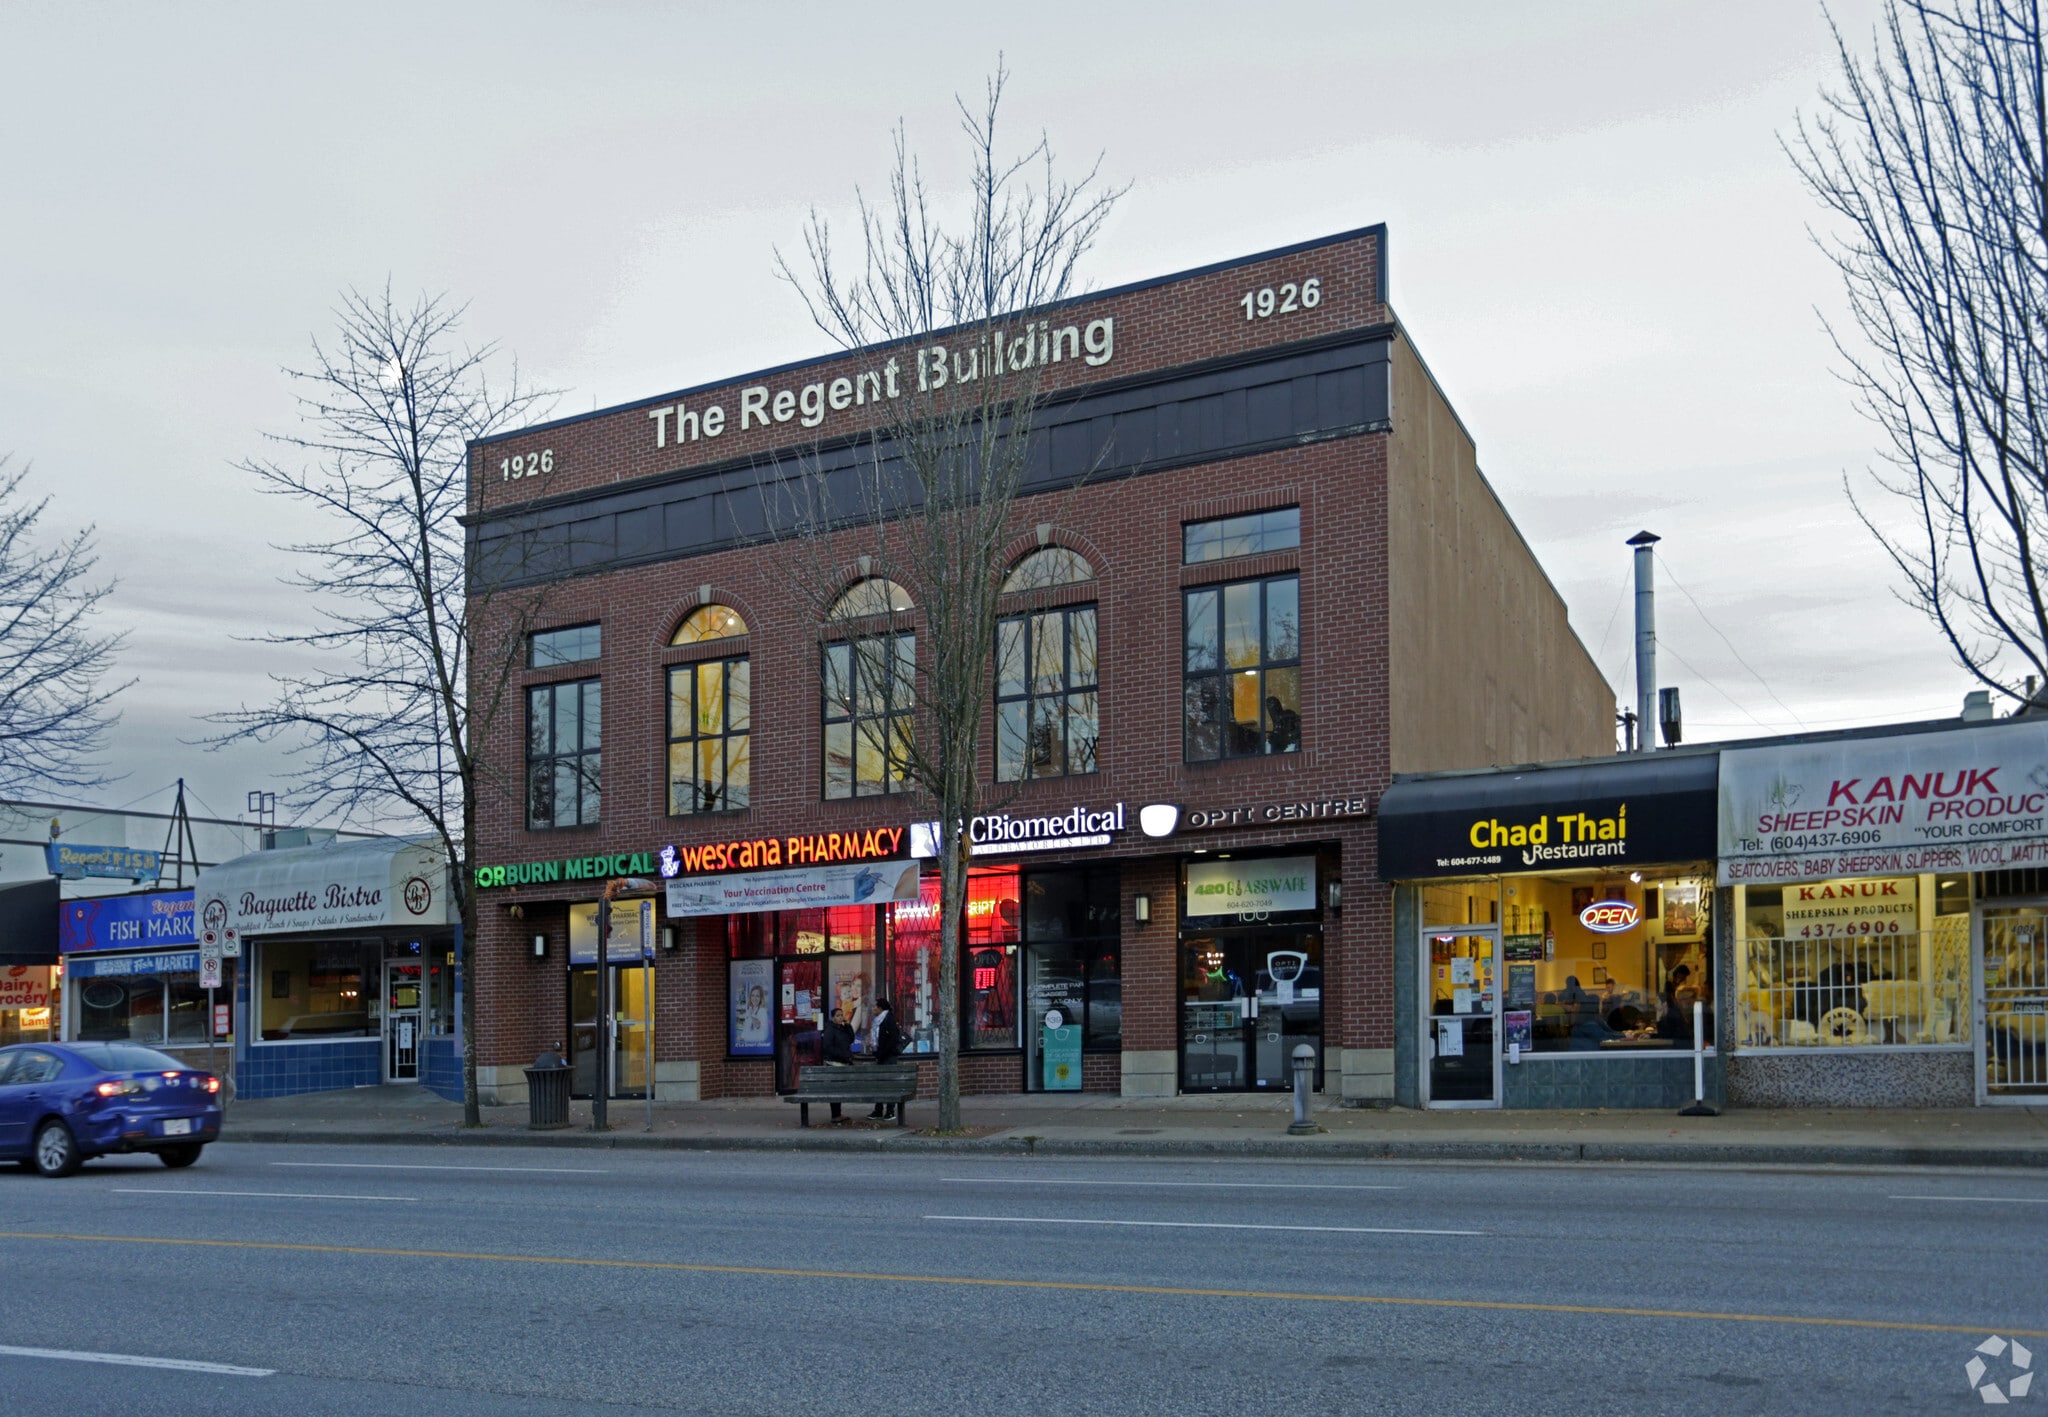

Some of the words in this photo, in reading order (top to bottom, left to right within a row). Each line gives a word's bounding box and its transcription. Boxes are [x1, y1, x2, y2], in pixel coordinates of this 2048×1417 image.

[1240, 279, 1321, 321] 1926
[649, 403, 725, 449] The
[740, 357, 900, 428] Regent
[917, 316, 1114, 393] Building
[500, 449, 554, 481] 1926
[1827, 766, 2001, 807] KANUK
[957, 803, 1125, 843] CBiomedical
[1187, 808, 1255, 828] OPTI
[1263, 799, 1367, 821] CENTRE
[1757, 804, 1904, 834] SHEEPSKIN
[1926, 794, 2048, 822] PRODUC
[1469, 815, 1548, 849] Chad
[1556, 803, 1627, 842] Thai
[1739, 838, 1764, 852] Tel:
[1769, 829, 1882, 853] (604)437-6906
[1914, 823, 1963, 840] "YOUR
[1968, 817, 2044, 836] COMFORT
[788, 828, 904, 864] PHARMACY
[972, 838, 1073, 854] ABORATORIES
[1524, 840, 1626, 864] Restaurant
[112, 852, 155, 870] FISH
[566, 852, 655, 880] MEDICAL
[1436, 858, 1450, 867] Tel:
[1450, 855, 1501, 866] 604-677-1489
[1728, 860, 1801, 880] SEATCOVERS,
[1804, 858, 1835, 876] BABY
[1838, 853, 1904, 875] SHEEPSKIN,
[1904, 848, 1965, 870] SLIPPERS,
[1968, 847, 2006, 865] WOOL
[723, 888, 743, 899] Your
[744, 885, 794, 898] Vaccination
[796, 883, 826, 893] Centre
[1194, 883, 1225, 895] 420
[1799, 881, 1898, 901] KANUK
[238, 891, 317, 922] Baguette
[323, 883, 383, 911] Bistro
[1226, 899, 1273, 909] 604-620-7049
[1786, 906, 1849, 920] SHEEPSKIN
[1854, 903, 1914, 916] PRODUCTS
[1584, 908, 1638, 924] OPEN
[110, 920, 141, 941] FISH
[148, 916, 193, 938] MARK
[1801, 920, 1899, 938] 437-6906
[2011, 924, 2035, 935] 4008
[155, 954, 195, 971] MARKET
[0, 978, 34, 994] airy
